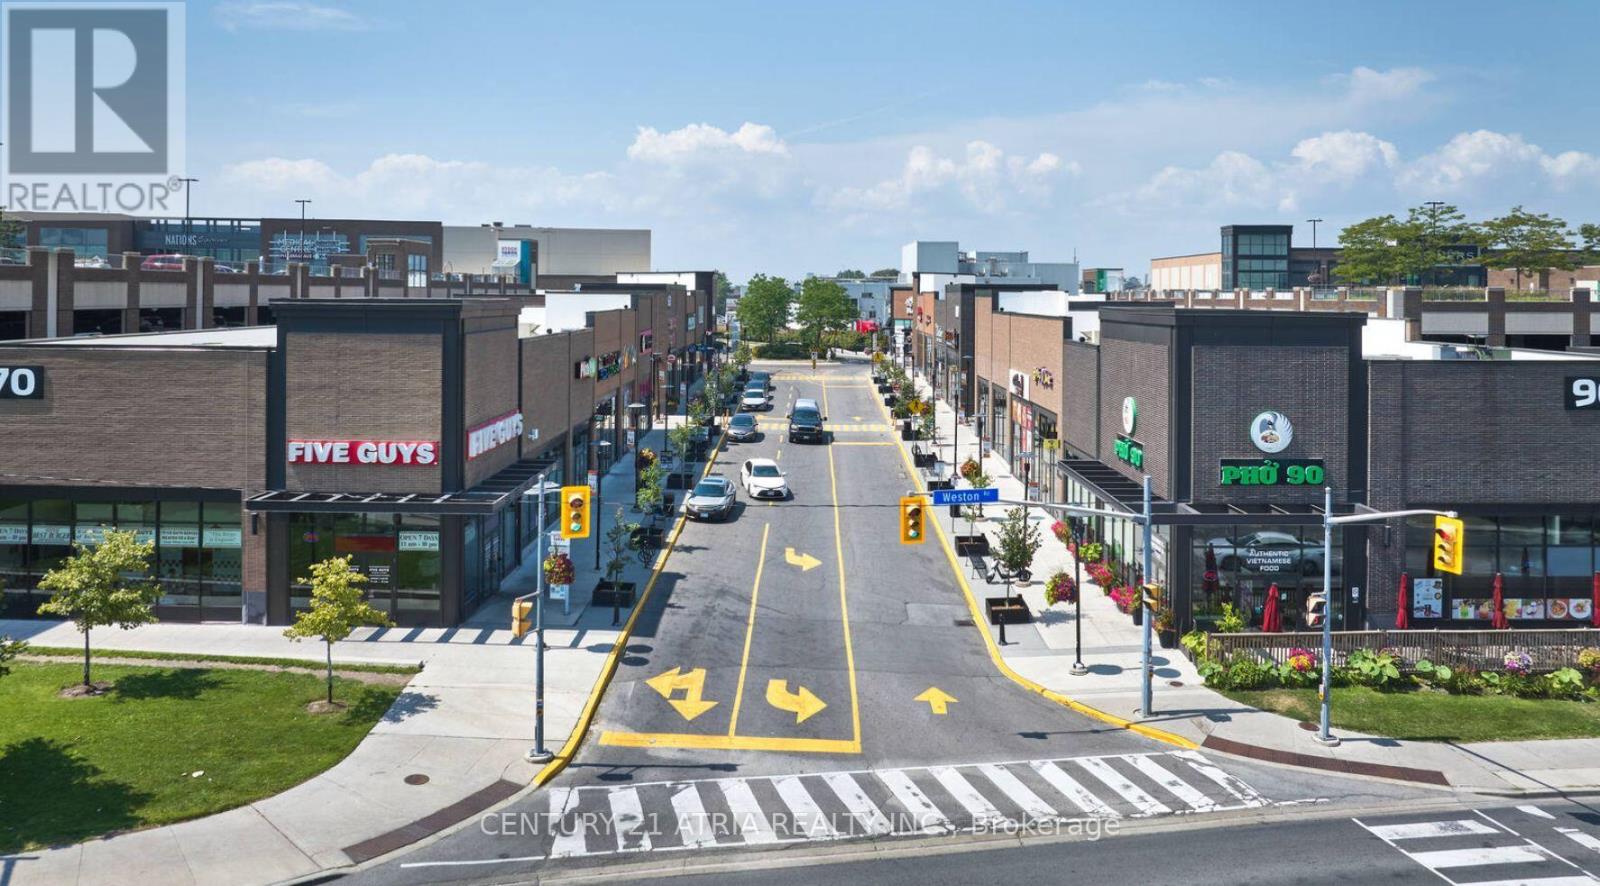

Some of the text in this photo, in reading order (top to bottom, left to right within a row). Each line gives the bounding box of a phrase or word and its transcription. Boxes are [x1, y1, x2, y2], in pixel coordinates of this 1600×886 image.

[165, 234, 197, 246] NATIONS
[1572, 379, 1600, 407] 9
[469, 413, 523, 457] FIVE GUYS
[288, 442, 435, 464] FIVE GUYS
[1286, 465, 1324, 485] 90
[942, 492, 980, 503] Weston
[1246, 557, 1292, 565] VIETNAMESE
[1249, 549, 1289, 557] AUTHENTIC
